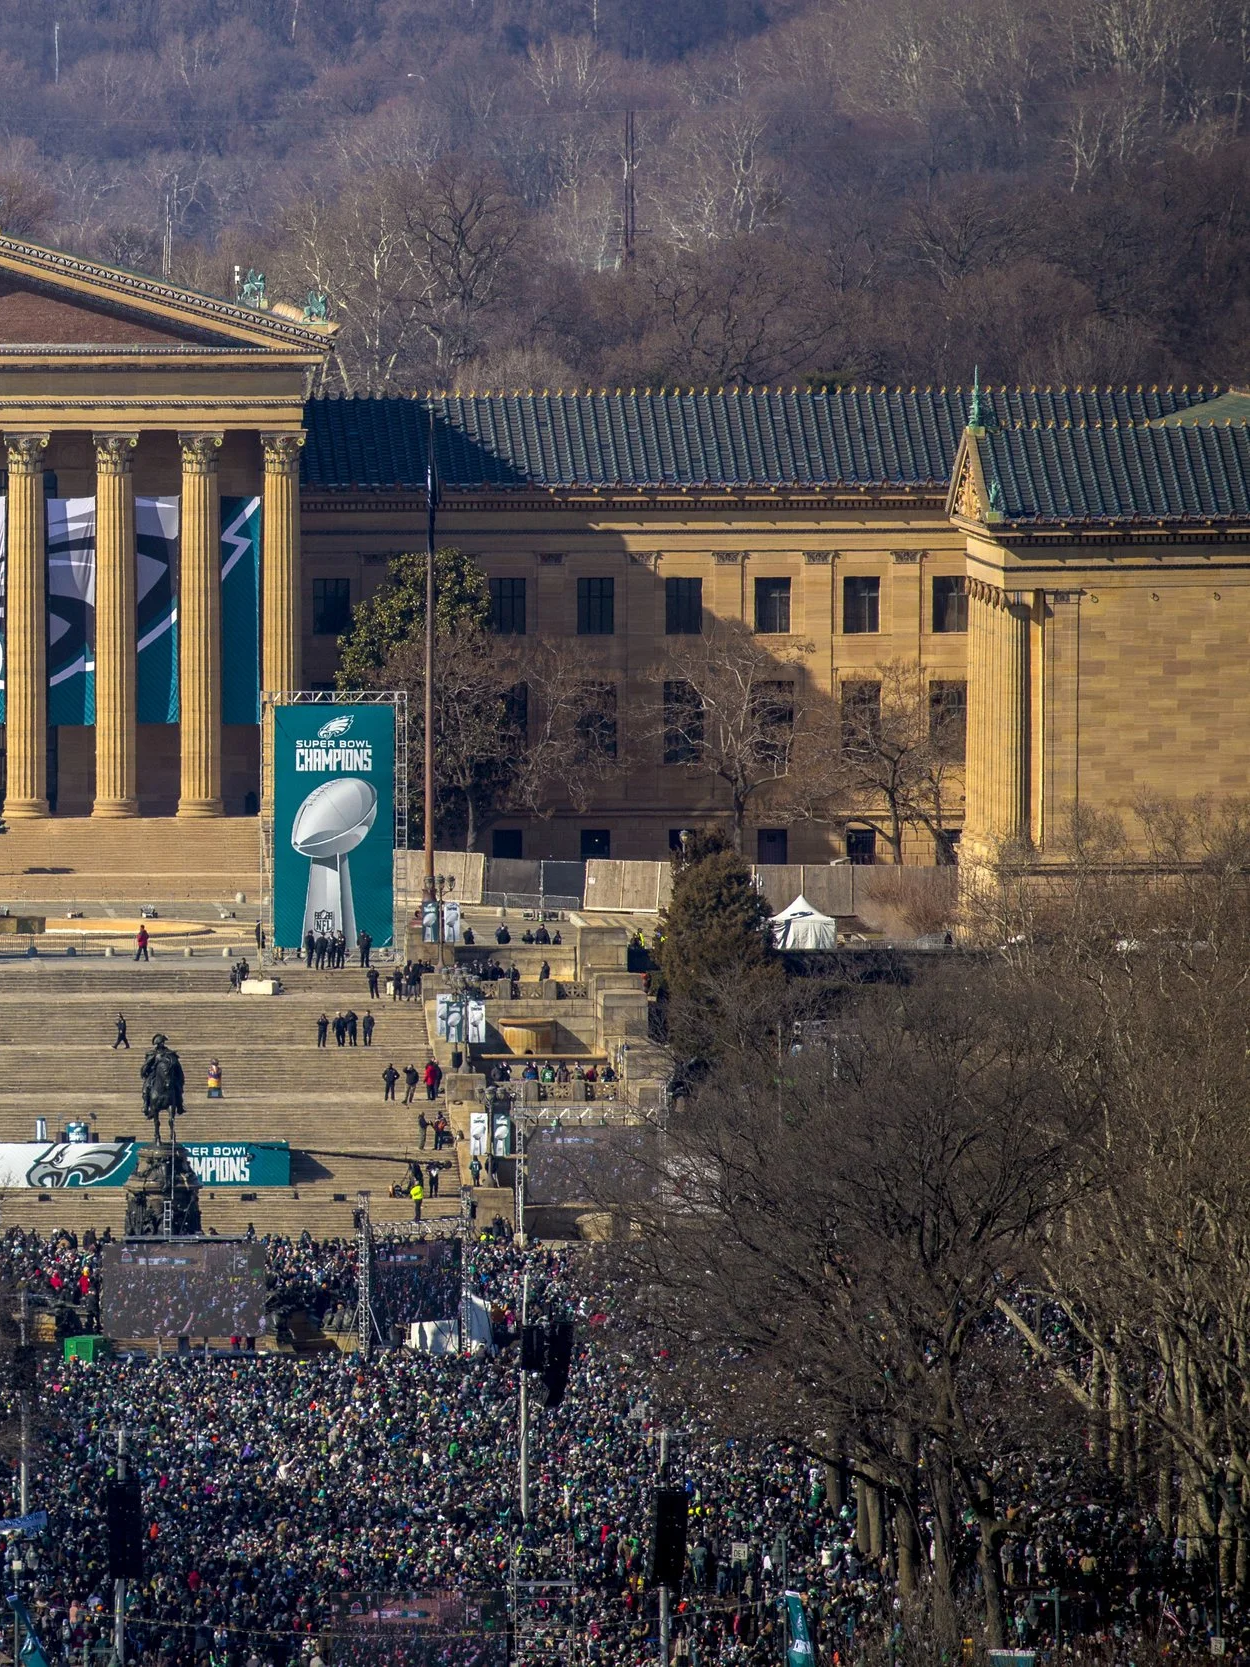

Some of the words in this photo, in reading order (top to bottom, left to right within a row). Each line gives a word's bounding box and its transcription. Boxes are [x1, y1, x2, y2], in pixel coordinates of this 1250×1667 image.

[296, 750, 372, 771] CHAMPIONS
[316, 921, 332, 931] NFL
[187, 1157, 250, 1182] MPIONS
